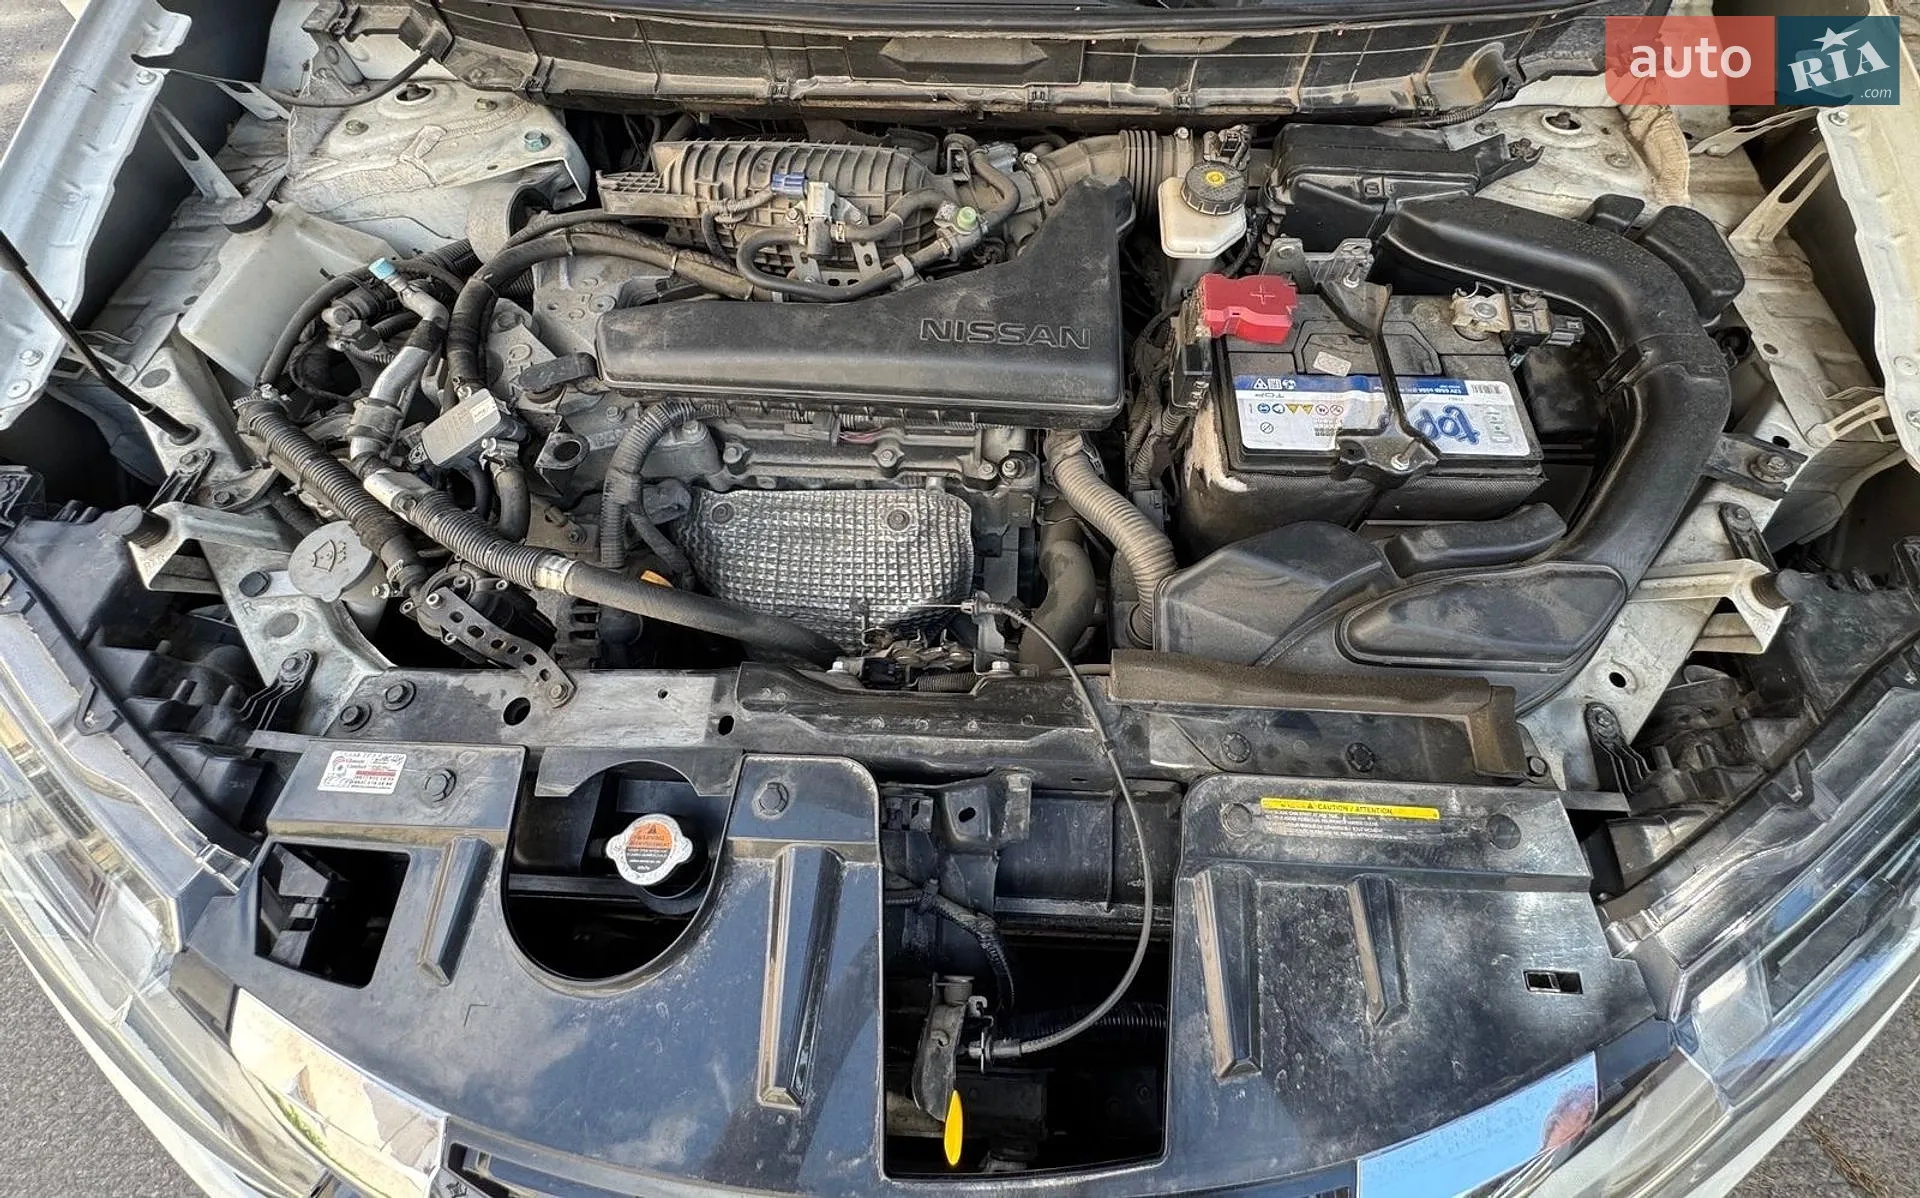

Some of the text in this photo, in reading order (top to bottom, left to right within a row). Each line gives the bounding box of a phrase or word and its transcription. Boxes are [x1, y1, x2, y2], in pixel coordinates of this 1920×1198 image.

[920, 317, 1091, 350] NISSAN
[1414, 405, 1481, 444] top
[1317, 803, 1349, 812] CAUTION
[1355, 805, 1393, 815] ATTENTION
